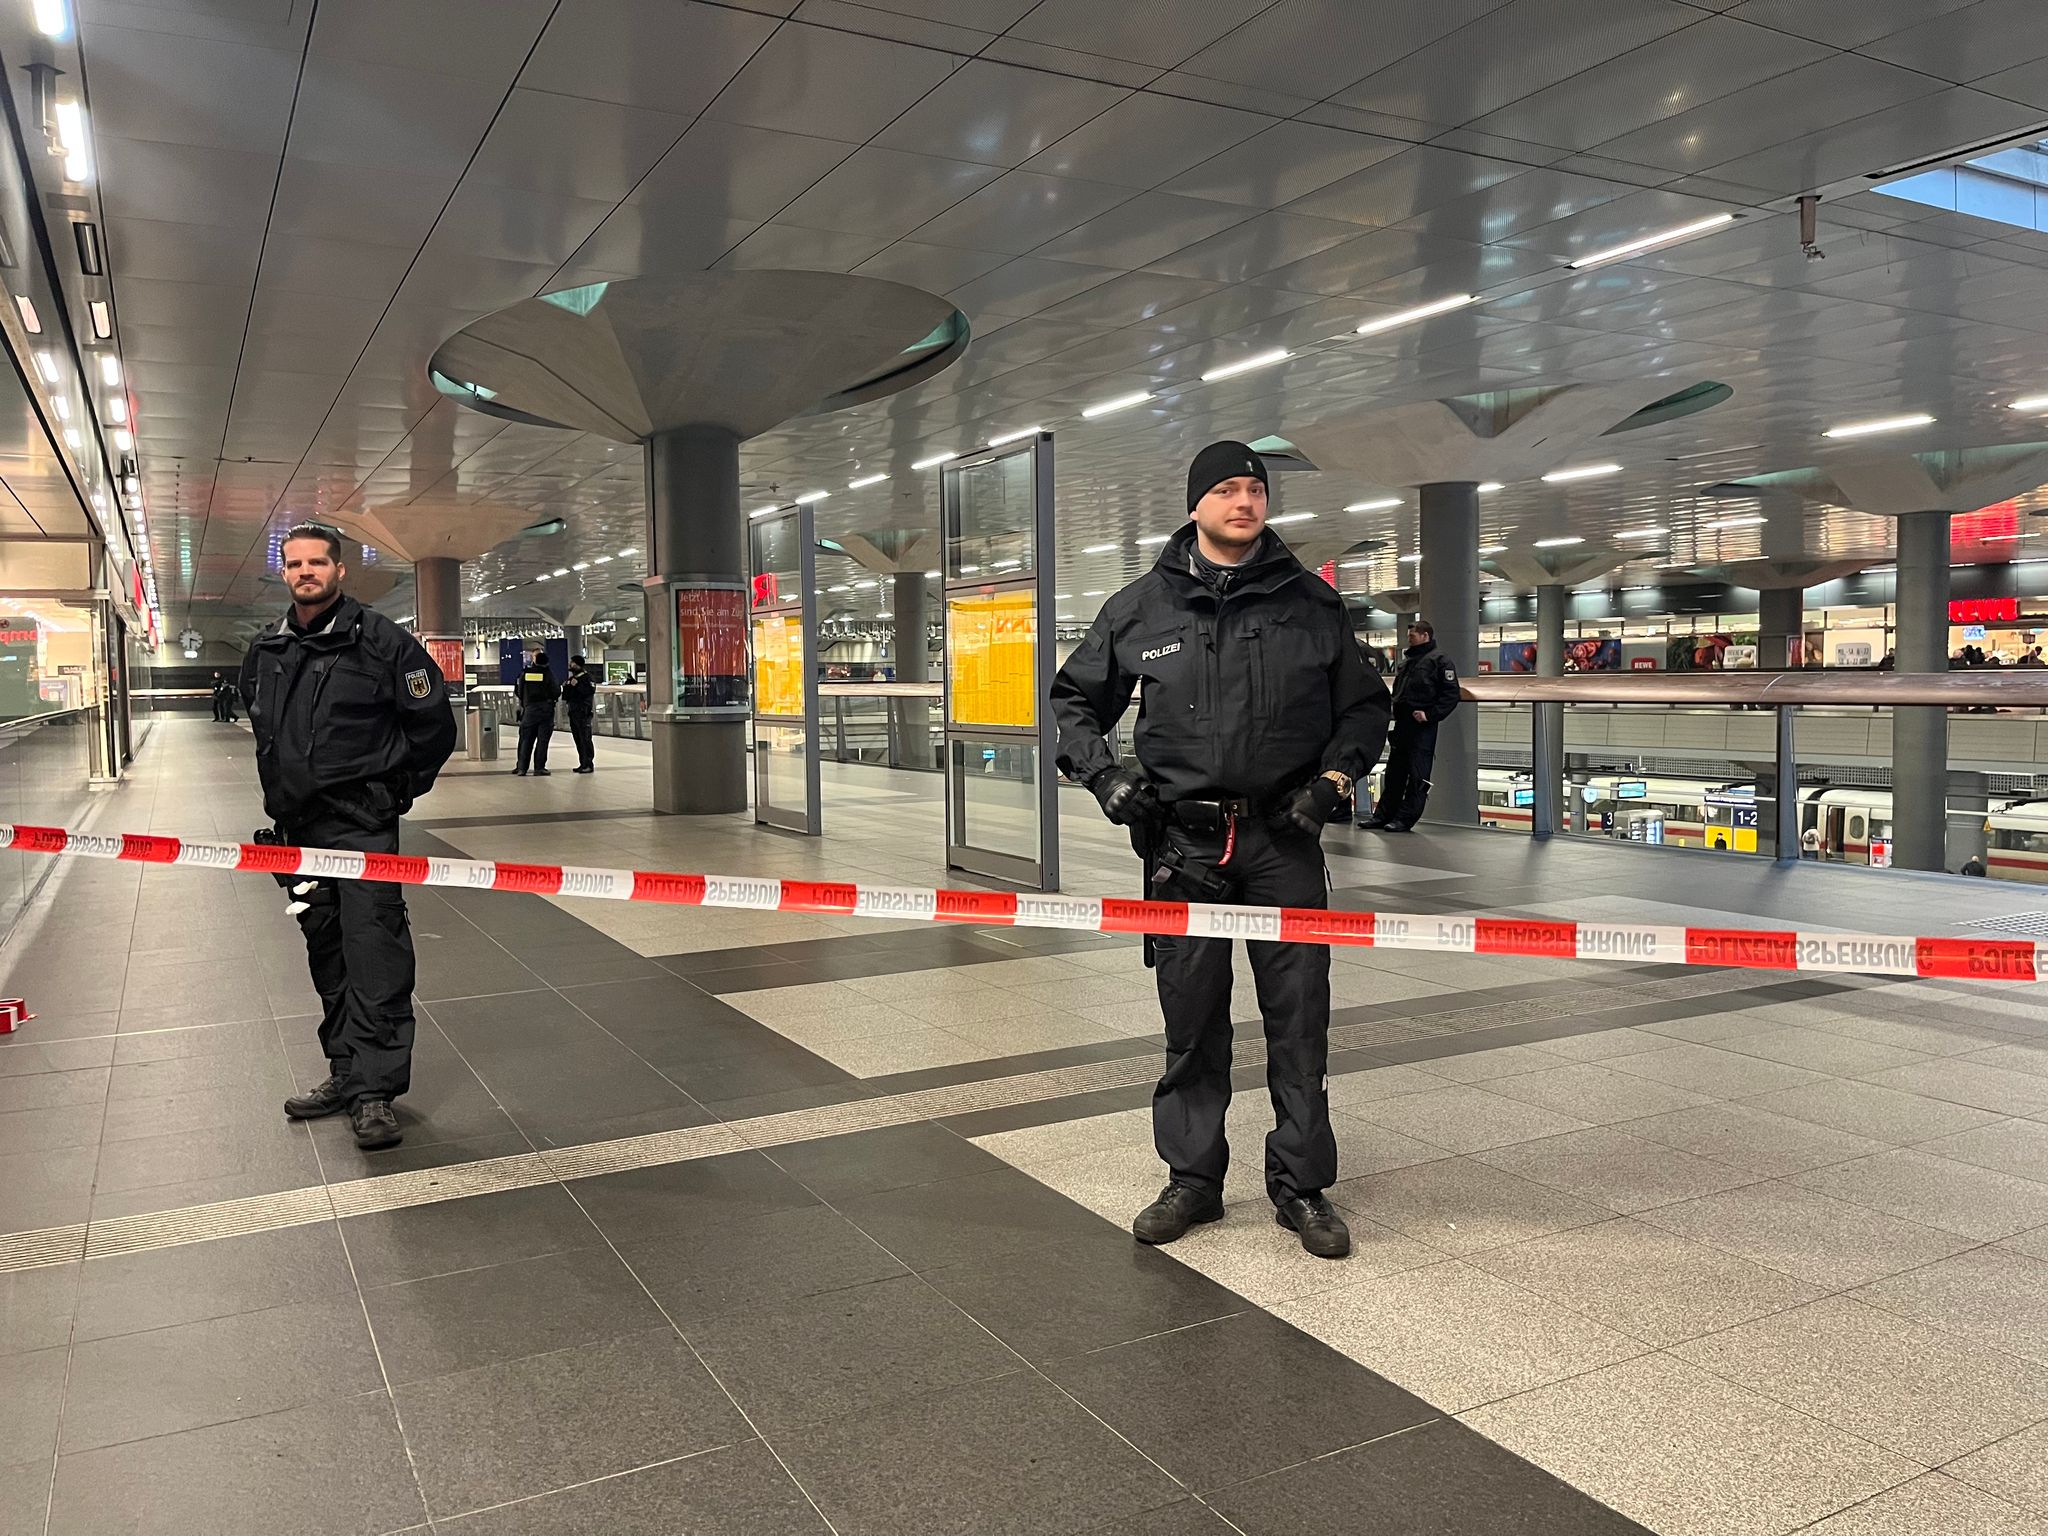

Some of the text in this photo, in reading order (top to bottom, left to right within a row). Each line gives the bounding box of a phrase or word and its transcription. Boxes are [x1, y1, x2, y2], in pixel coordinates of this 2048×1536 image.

[680, 607, 698, 616] sind
[701, 606, 714, 616] Sie
[1142, 642, 1181, 661] POLIZEI
[1606, 812, 1614, 826] 3
[1737, 810, 1758, 826] 1-2
